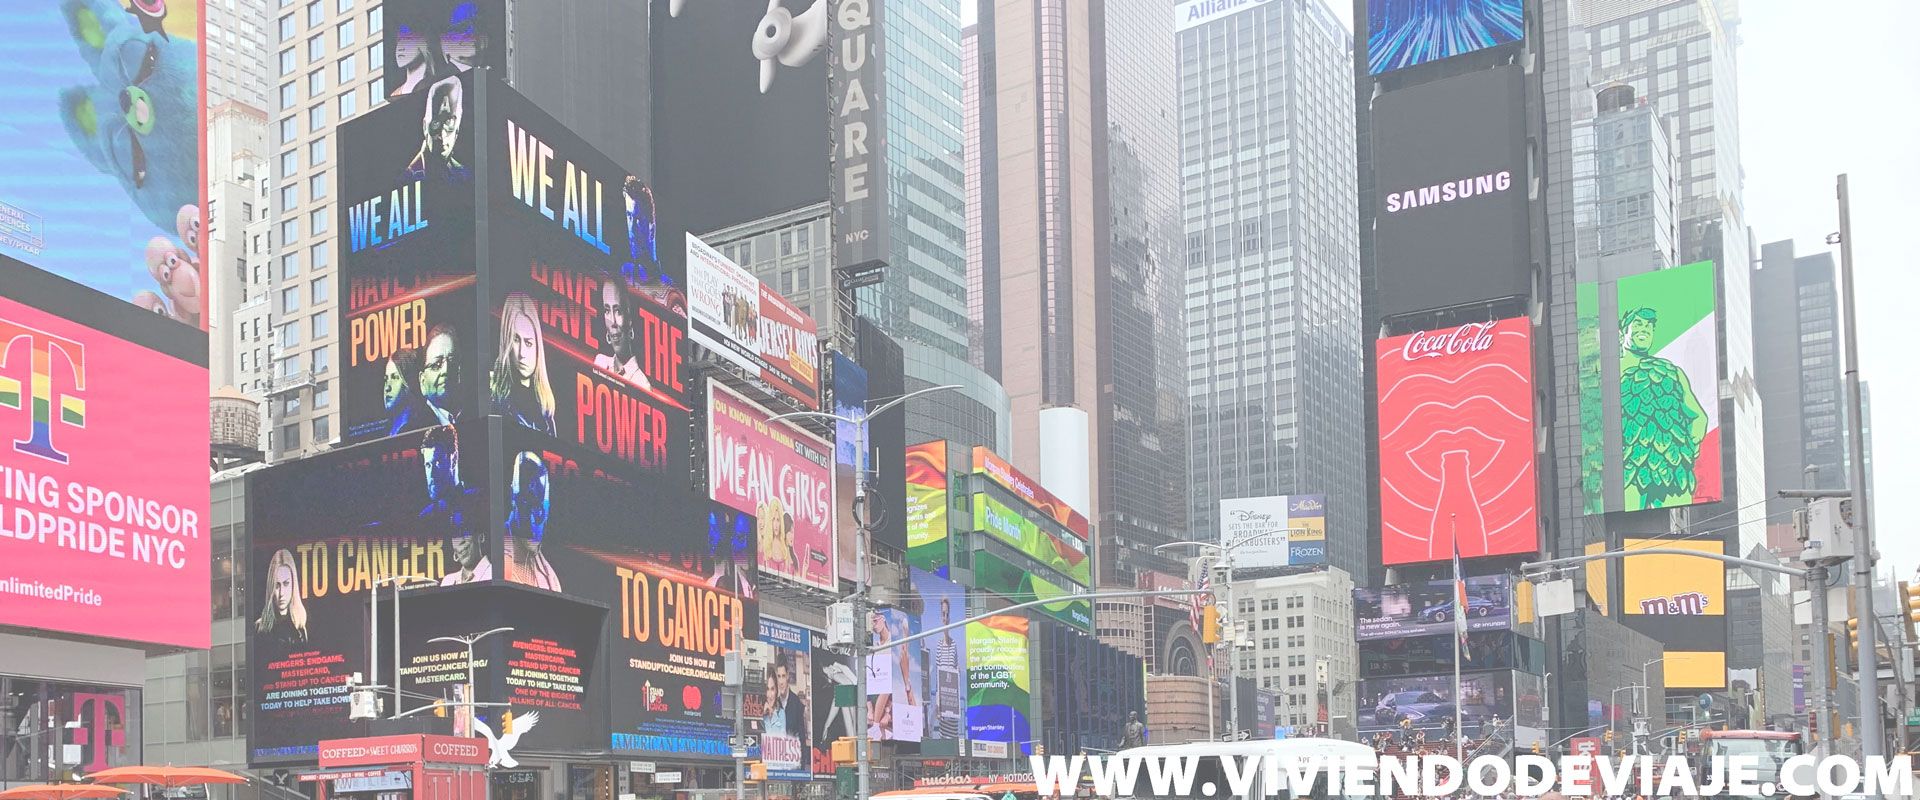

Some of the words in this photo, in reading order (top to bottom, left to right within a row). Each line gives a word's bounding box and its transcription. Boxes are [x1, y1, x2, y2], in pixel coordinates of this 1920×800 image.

[507, 119, 554, 221] WE
[563, 160, 611, 256] ALL
[1387, 171, 1511, 213] SAMSUNG
[349, 195, 382, 254] WE
[388, 180, 428, 240] ALL
[845, 229, 869, 245] NYC
[351, 298, 427, 367] POWER
[760, 315, 793, 361] JERSEY
[639, 307, 683, 393] THE
[577, 372, 667, 469] POWER
[729, 406, 752, 427] KNOW
[754, 419, 769, 437] YOU
[770, 428, 795, 450] WANNA
[795, 442, 805, 456] SIT
[804, 446, 820, 464] WITH
[715, 433, 775, 504] MEAN
[779, 463, 829, 533] GIRLS
[0, 466, 59, 508] ING
[67, 482, 198, 538] SPONSOR
[986, 506, 1002, 531] Pride
[132, 531, 186, 569] NYC
[1290, 546, 1324, 558] FROZEN
[297, 541, 329, 600] TO
[337, 536, 445, 594] CANCER
[616, 565, 650, 643] TO
[412, 655, 429, 664] JOIN
[429, 653, 440, 662] US
[440, 652, 458, 661] NOW
[459, 651, 469, 659] AT
[685, 656, 693, 665] US
[708, 661, 716, 669] AT
[400, 659, 488, 675] TANDUPTOCANCER.RG/
[310, 678, 320, 686] TO
[415, 672, 467, 684] MASTERCARD.
[511, 668, 524, 677] ARE
[549, 673, 579, 684] TOGETHER
[978, 671, 989, 680] the
[506, 677, 526, 686] TODAY
[527, 679, 536, 687] TO
[536, 680, 552, 689] HELP
[552, 682, 566, 691] TAKE
[970, 680, 1010, 689] community.
[266, 691, 280, 701] ARE
[281, 688, 309, 699] JOINING
[309, 685, 348, 696] TOGETHER
[261, 702, 283, 711] TODAY
[284, 700, 293, 708] TO
[294, 698, 312, 708] HELP
[313, 697, 331, 706] TAKE
[322, 747, 366, 759] COFFEED
[434, 743, 478, 757] COFFEED
[921, 773, 972, 786] nuchas
[988, 774, 998, 783] NY
